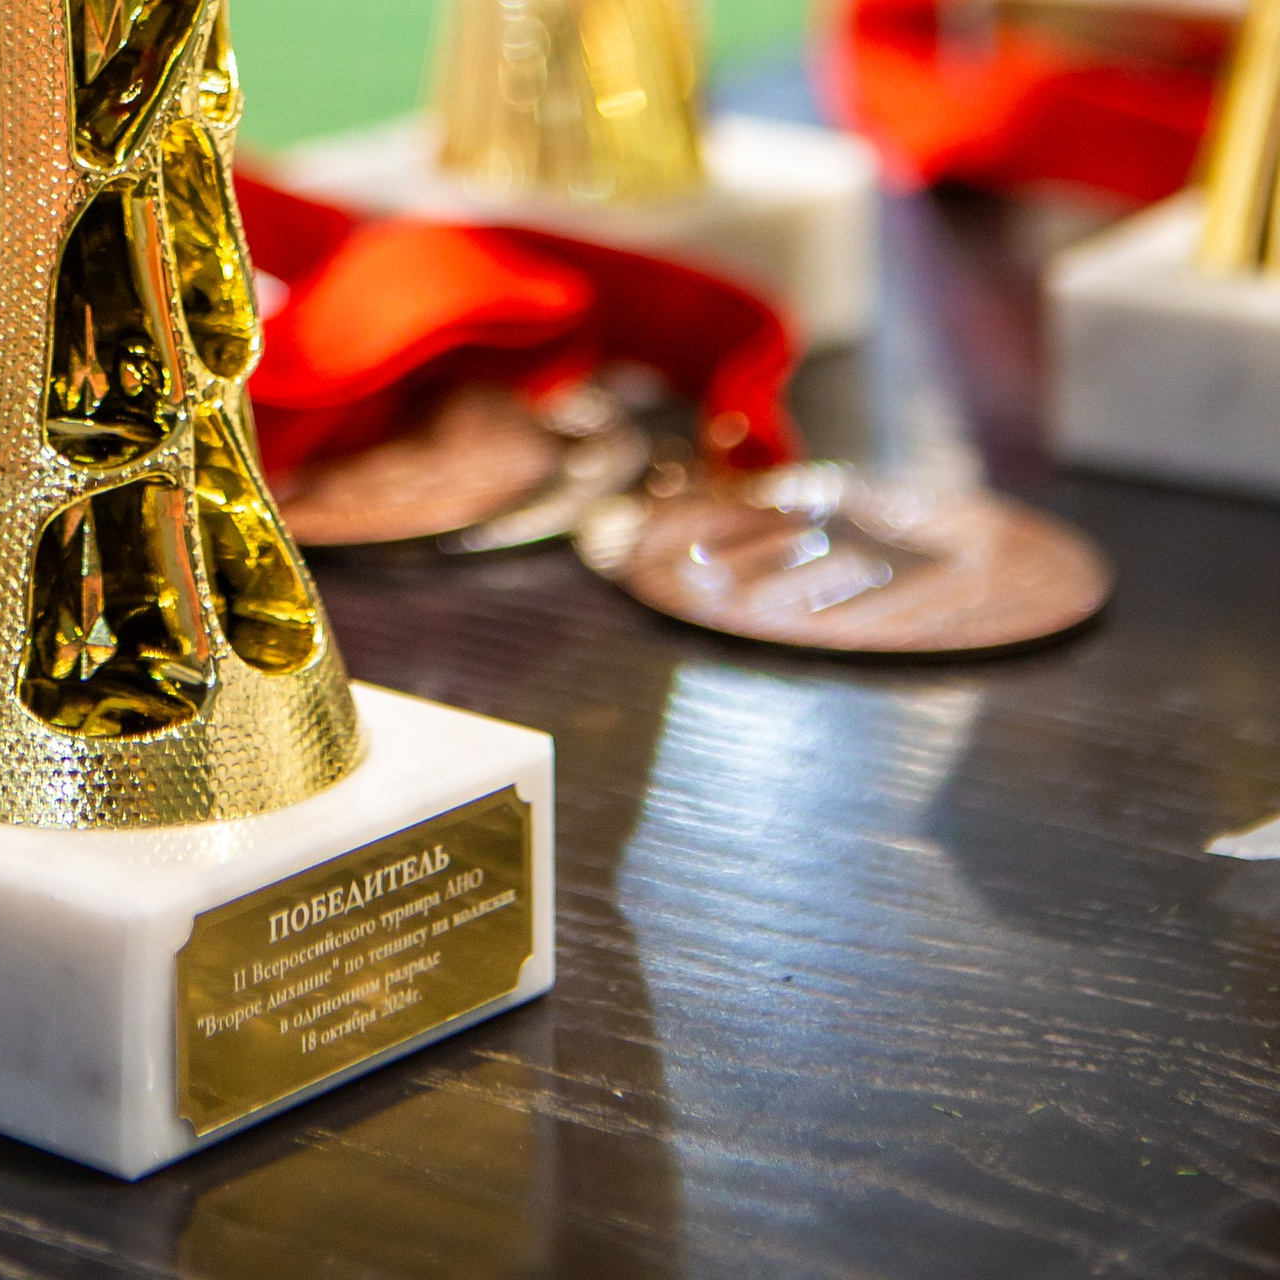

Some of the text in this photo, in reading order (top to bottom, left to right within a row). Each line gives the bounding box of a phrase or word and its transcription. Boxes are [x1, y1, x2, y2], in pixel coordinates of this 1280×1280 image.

[253, 919, 376, 985] Всероссийского
[380, 892, 440, 931] турнира
[444, 868, 484, 900] АНО
[269, 845, 451, 943] ПОБЕДИТЕЛЬ
[267, 958, 340, 1013] дыхание"
[344, 956, 364, 974] по
[369, 926, 428, 964] теннису
[431, 918, 450, 937] на
[280, 950, 441, 1034] в одиночном разряде
[301, 1033, 316, 1054] 18
[321, 1008, 377, 1044] октября
